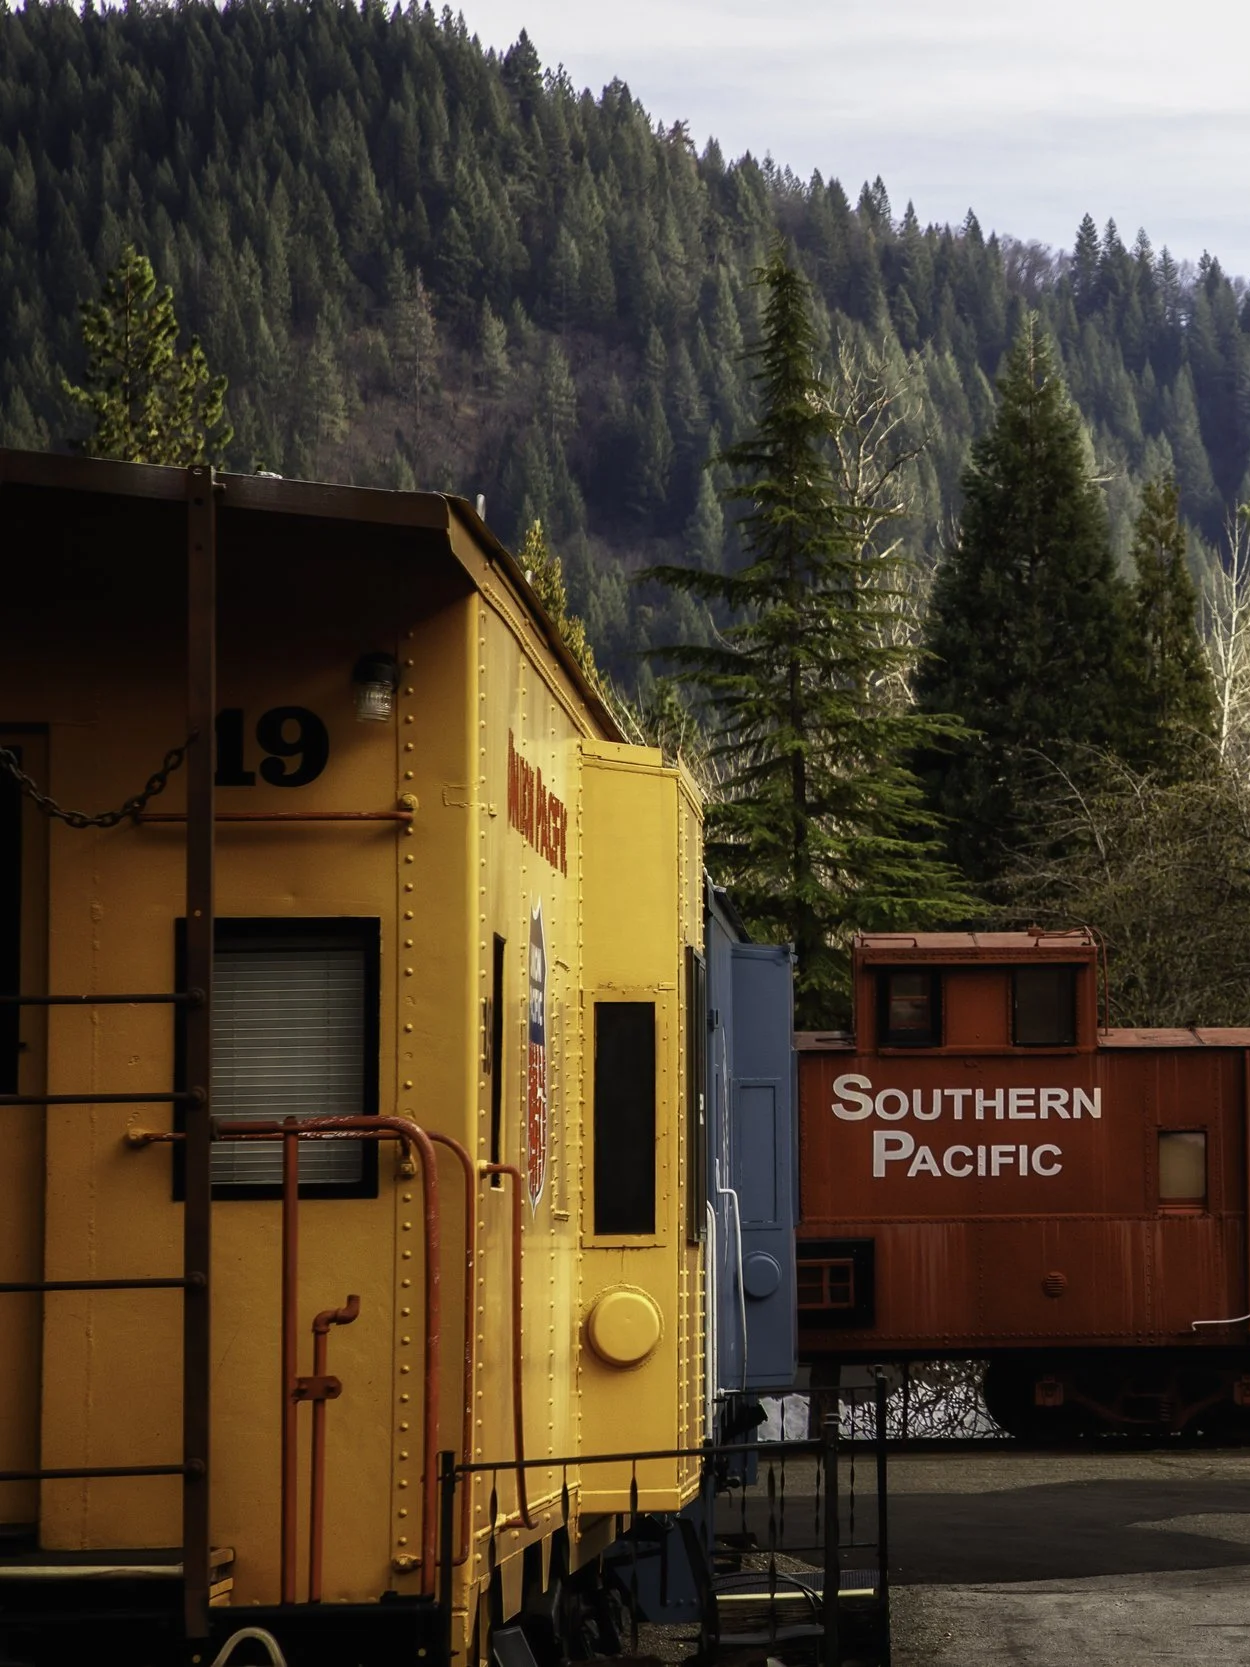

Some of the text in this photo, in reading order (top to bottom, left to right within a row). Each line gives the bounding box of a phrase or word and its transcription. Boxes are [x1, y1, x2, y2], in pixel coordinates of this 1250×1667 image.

[215, 706, 329, 787] 19
[831, 1074, 1102, 1120] SOUTHERN
[872, 1130, 1063, 1177] PACIFIC
